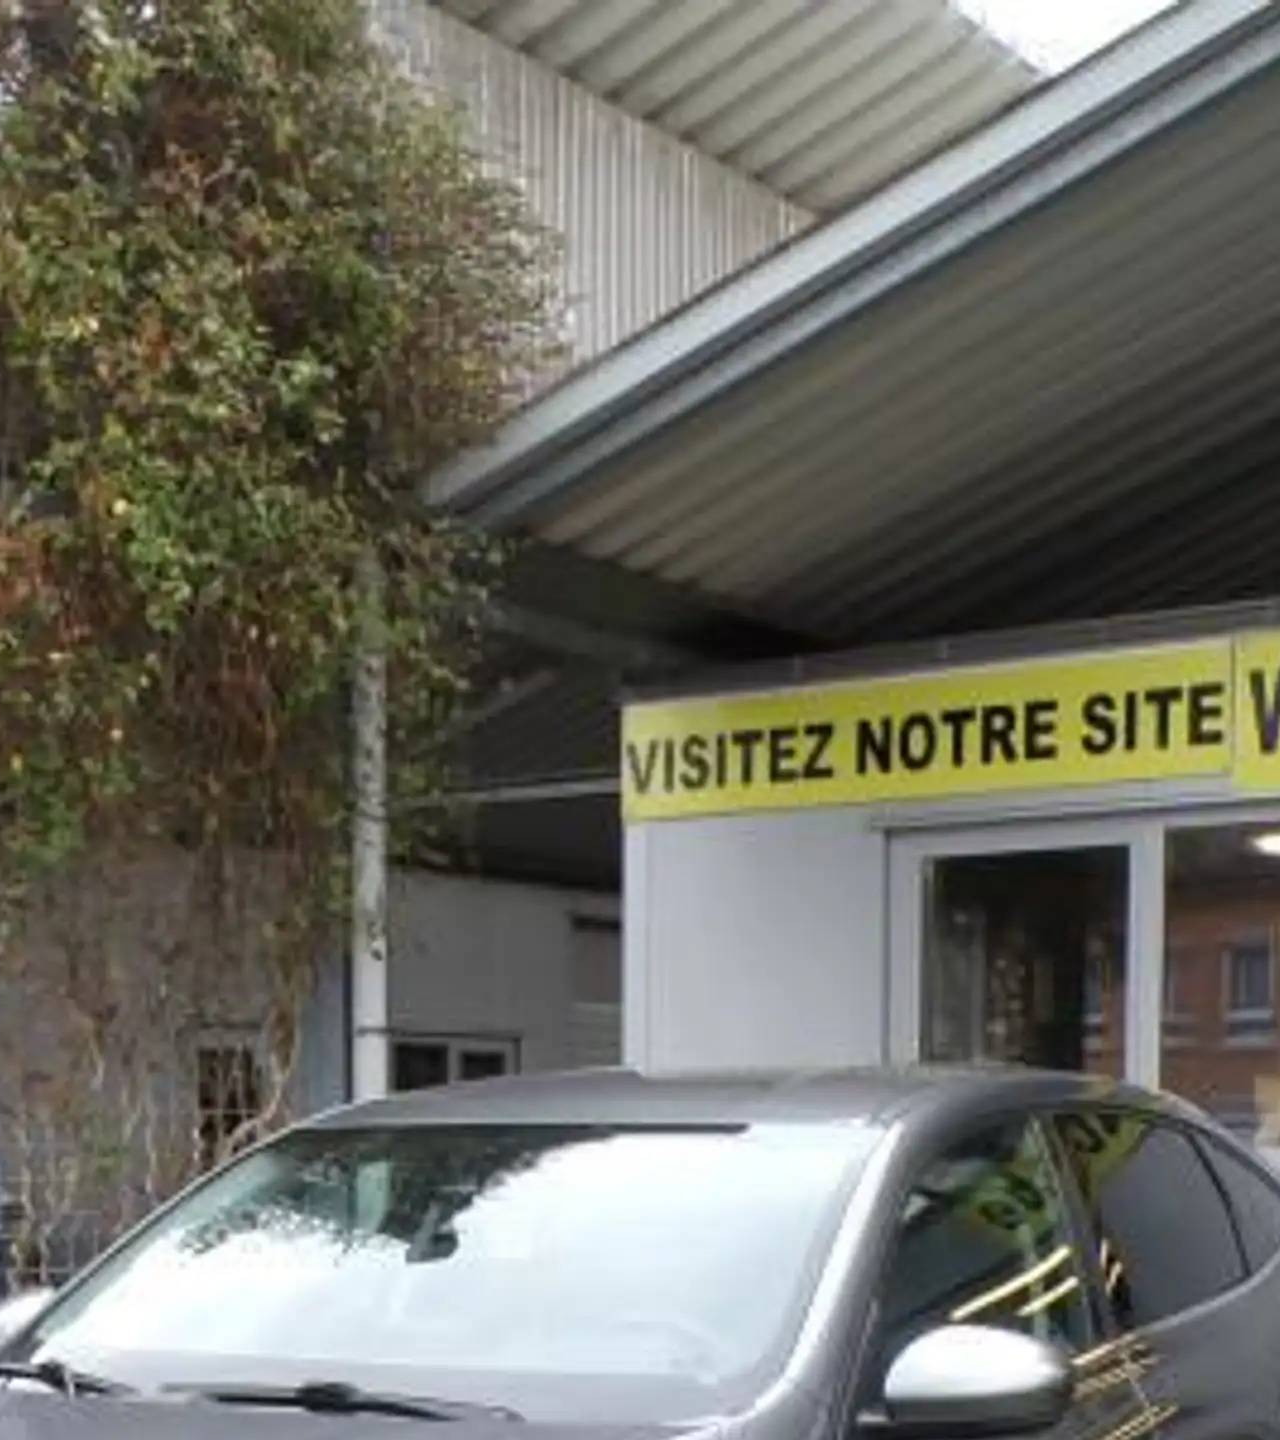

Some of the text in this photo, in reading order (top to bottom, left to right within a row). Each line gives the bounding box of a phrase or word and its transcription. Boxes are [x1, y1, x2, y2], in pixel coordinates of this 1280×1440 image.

[626, 725, 835, 795] VISITEZ
[855, 702, 1059, 775] NOTRE
[1081, 684, 1224, 755] SITE
